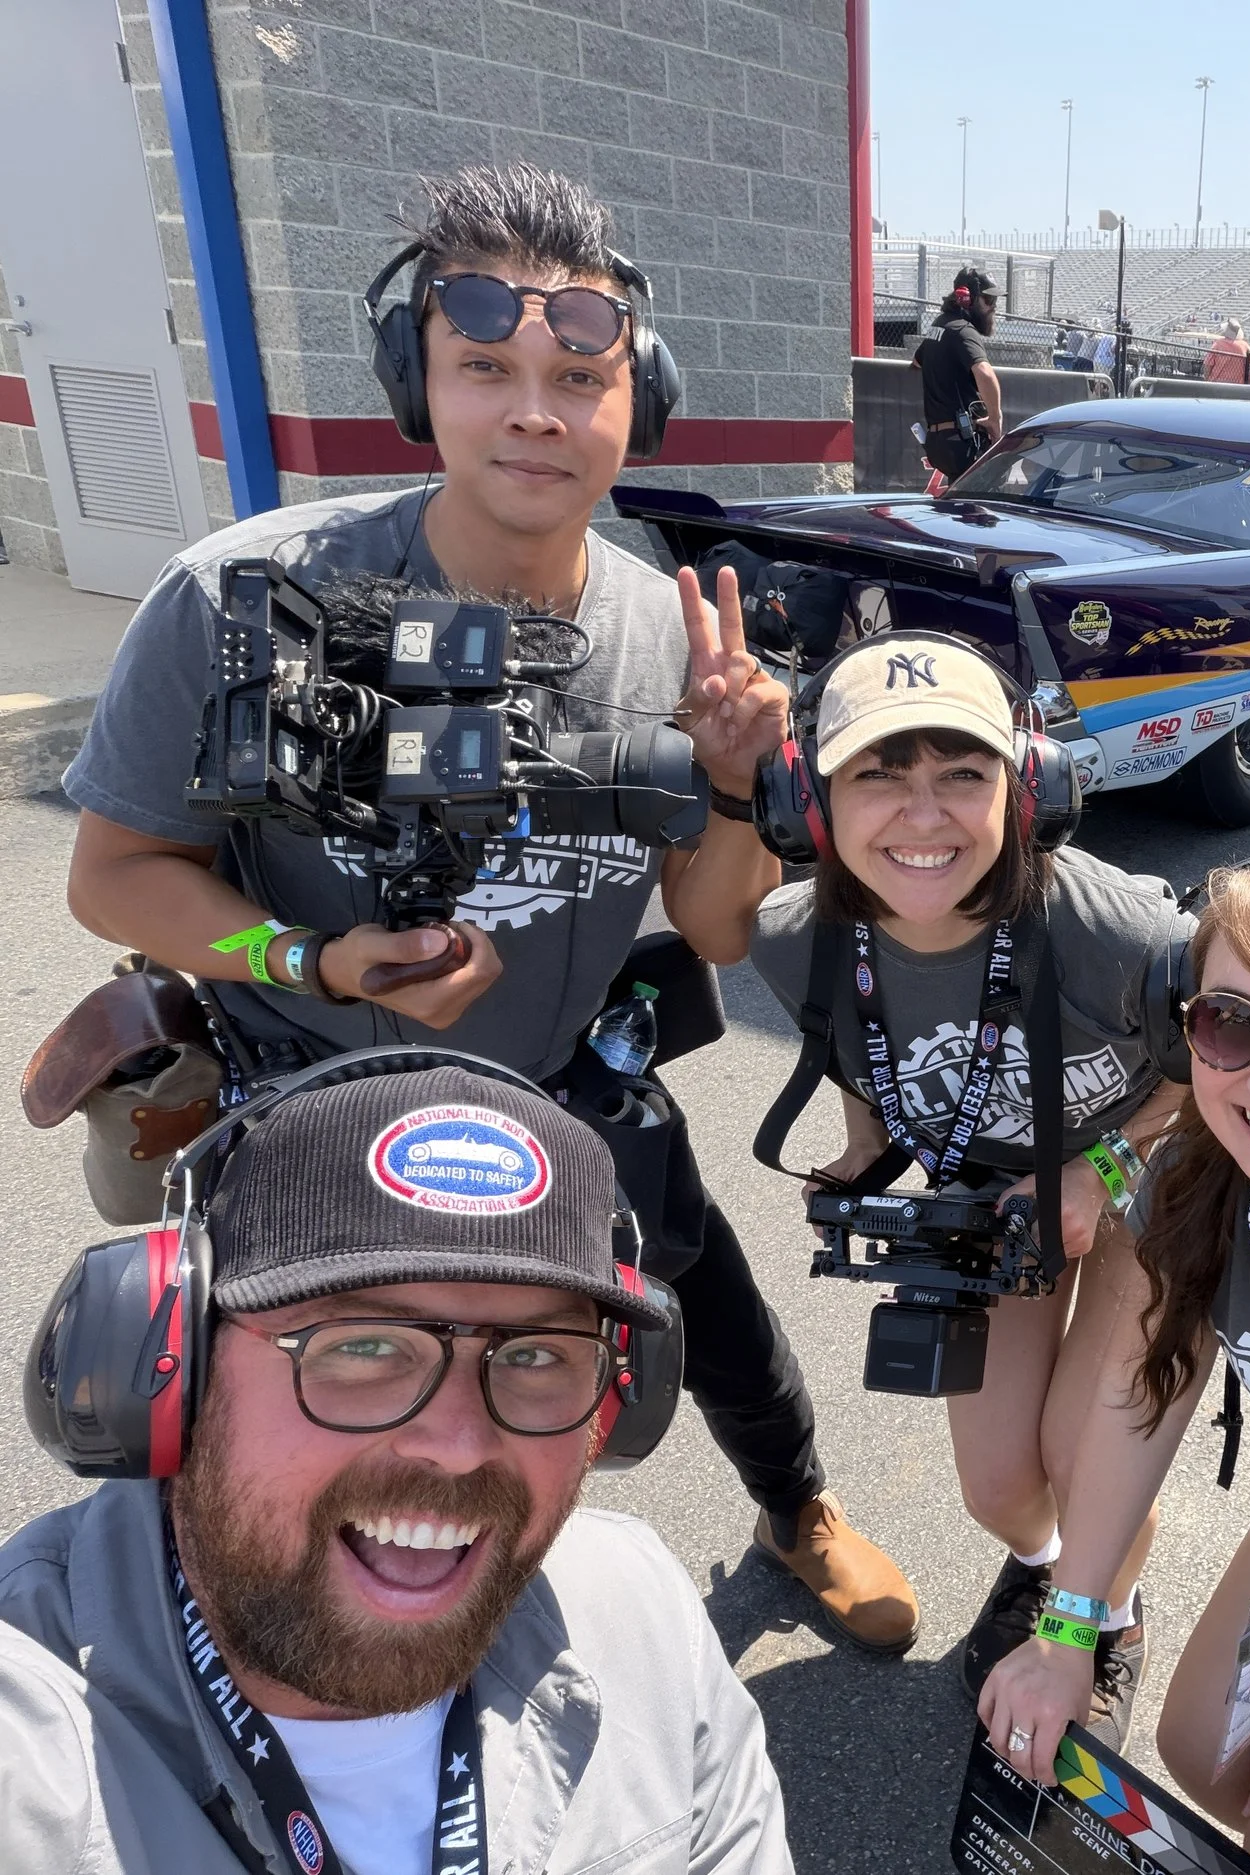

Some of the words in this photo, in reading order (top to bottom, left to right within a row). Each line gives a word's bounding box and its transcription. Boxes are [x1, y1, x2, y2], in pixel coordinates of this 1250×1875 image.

[1071, 619, 1110, 631] SPORTSMAN
[1083, 613, 1099, 622] TOP
[1193, 616, 1235, 632] Racing
[402, 624, 427, 657] R2
[1136, 717, 1182, 740] MSD
[1130, 750, 1184, 774] RICHMOND
[989, 952, 1011, 980] ALL
[867, 1033, 888, 1061] ALL
[874, 1065, 894, 1091] FOR
[960, 1071, 991, 1117] SPEED
[407, 1107, 471, 1127] NATIONAL
[475, 1110, 499, 1125] HOT
[501, 1119, 525, 1139] ROD
[879, 1092, 907, 1139] SPEED
[949, 1113, 976, 1146] FOR
[940, 1142, 965, 1177] ALL
[1094, 1155, 1113, 1177] RAP
[403, 1164, 467, 1180] DEDICATED
[468, 1168, 484, 1182] TO
[486, 1171, 525, 1190] SAFETY
[417, 1190, 506, 1213] ASSOCIATION
[913, 1291, 941, 1304] Nitze
[1043, 1617, 1064, 1634] RAP
[208, 1671, 253, 1741] ALL
[993, 1761, 1024, 1791] ROLL
[440, 1783, 478, 1849] ALL
[293, 1819, 319, 1867] NHRA
[971, 1815, 1036, 1873] DIRECTOR:
[1072, 1827, 1111, 1860] SCENE
